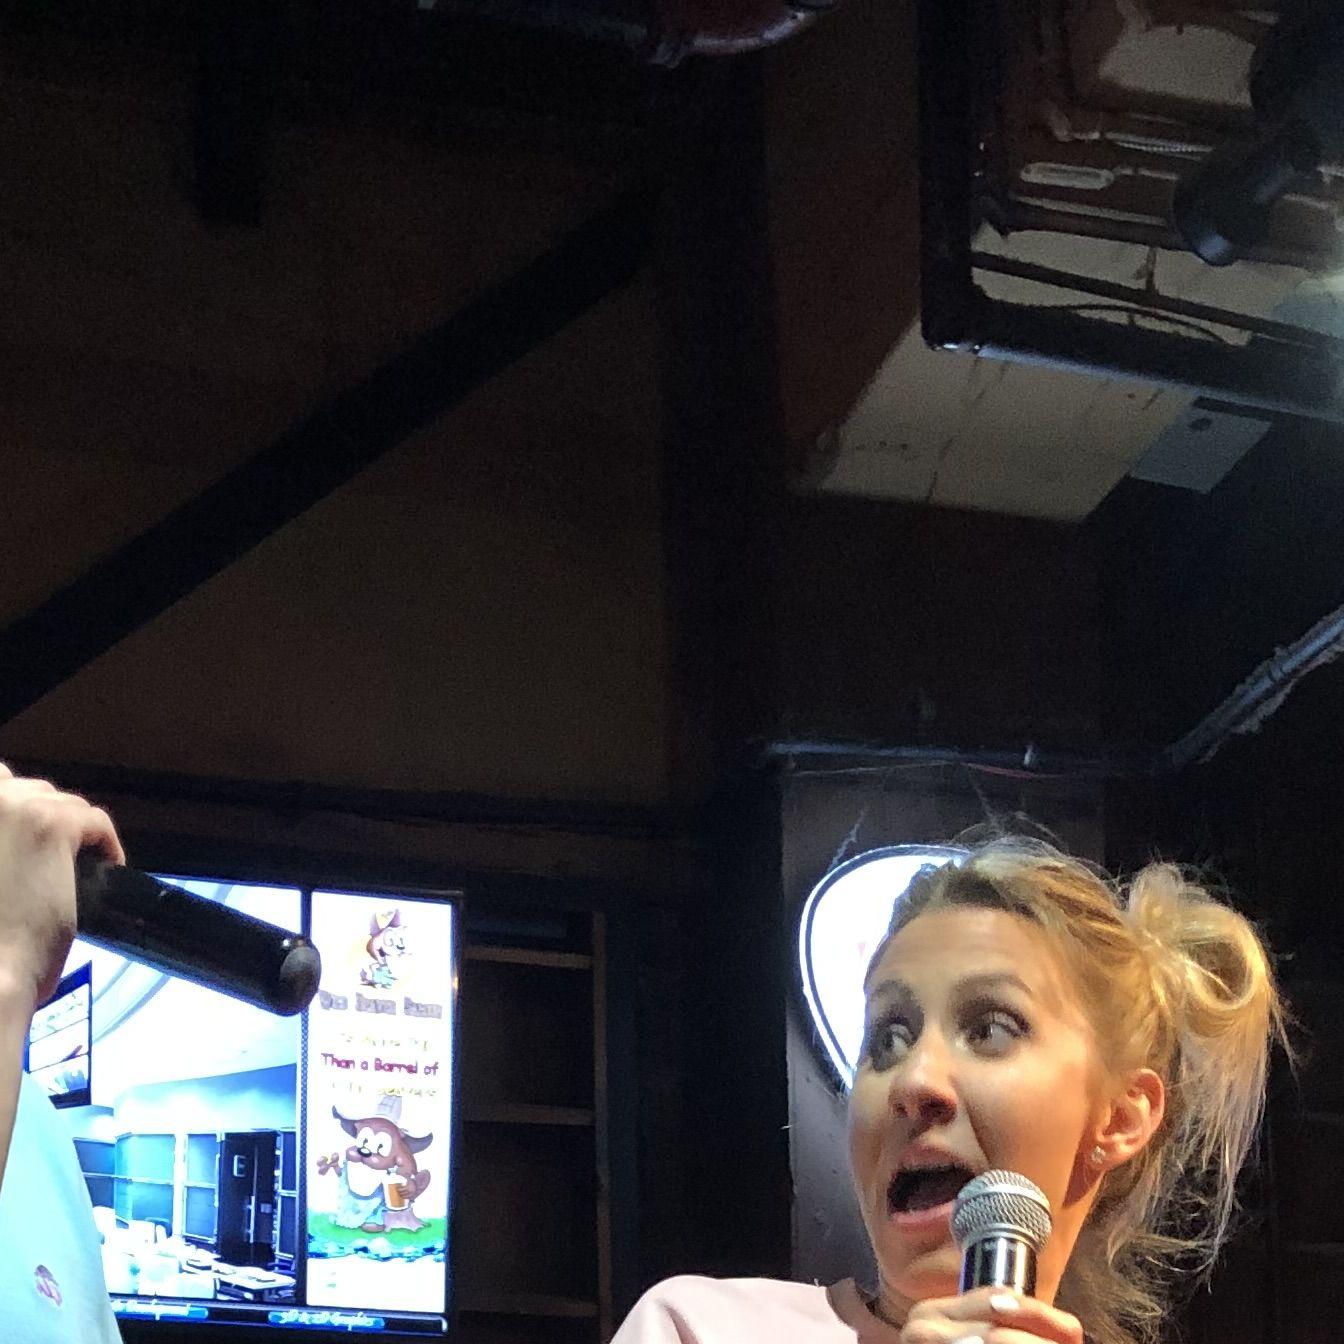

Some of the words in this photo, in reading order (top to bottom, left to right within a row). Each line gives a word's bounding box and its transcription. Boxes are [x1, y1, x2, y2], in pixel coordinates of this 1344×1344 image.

[320, 1052, 355, 1069] Than
[360, 1060, 369, 1071] a
[374, 1057, 418, 1074] Barrel
[423, 1061, 439, 1076] of
